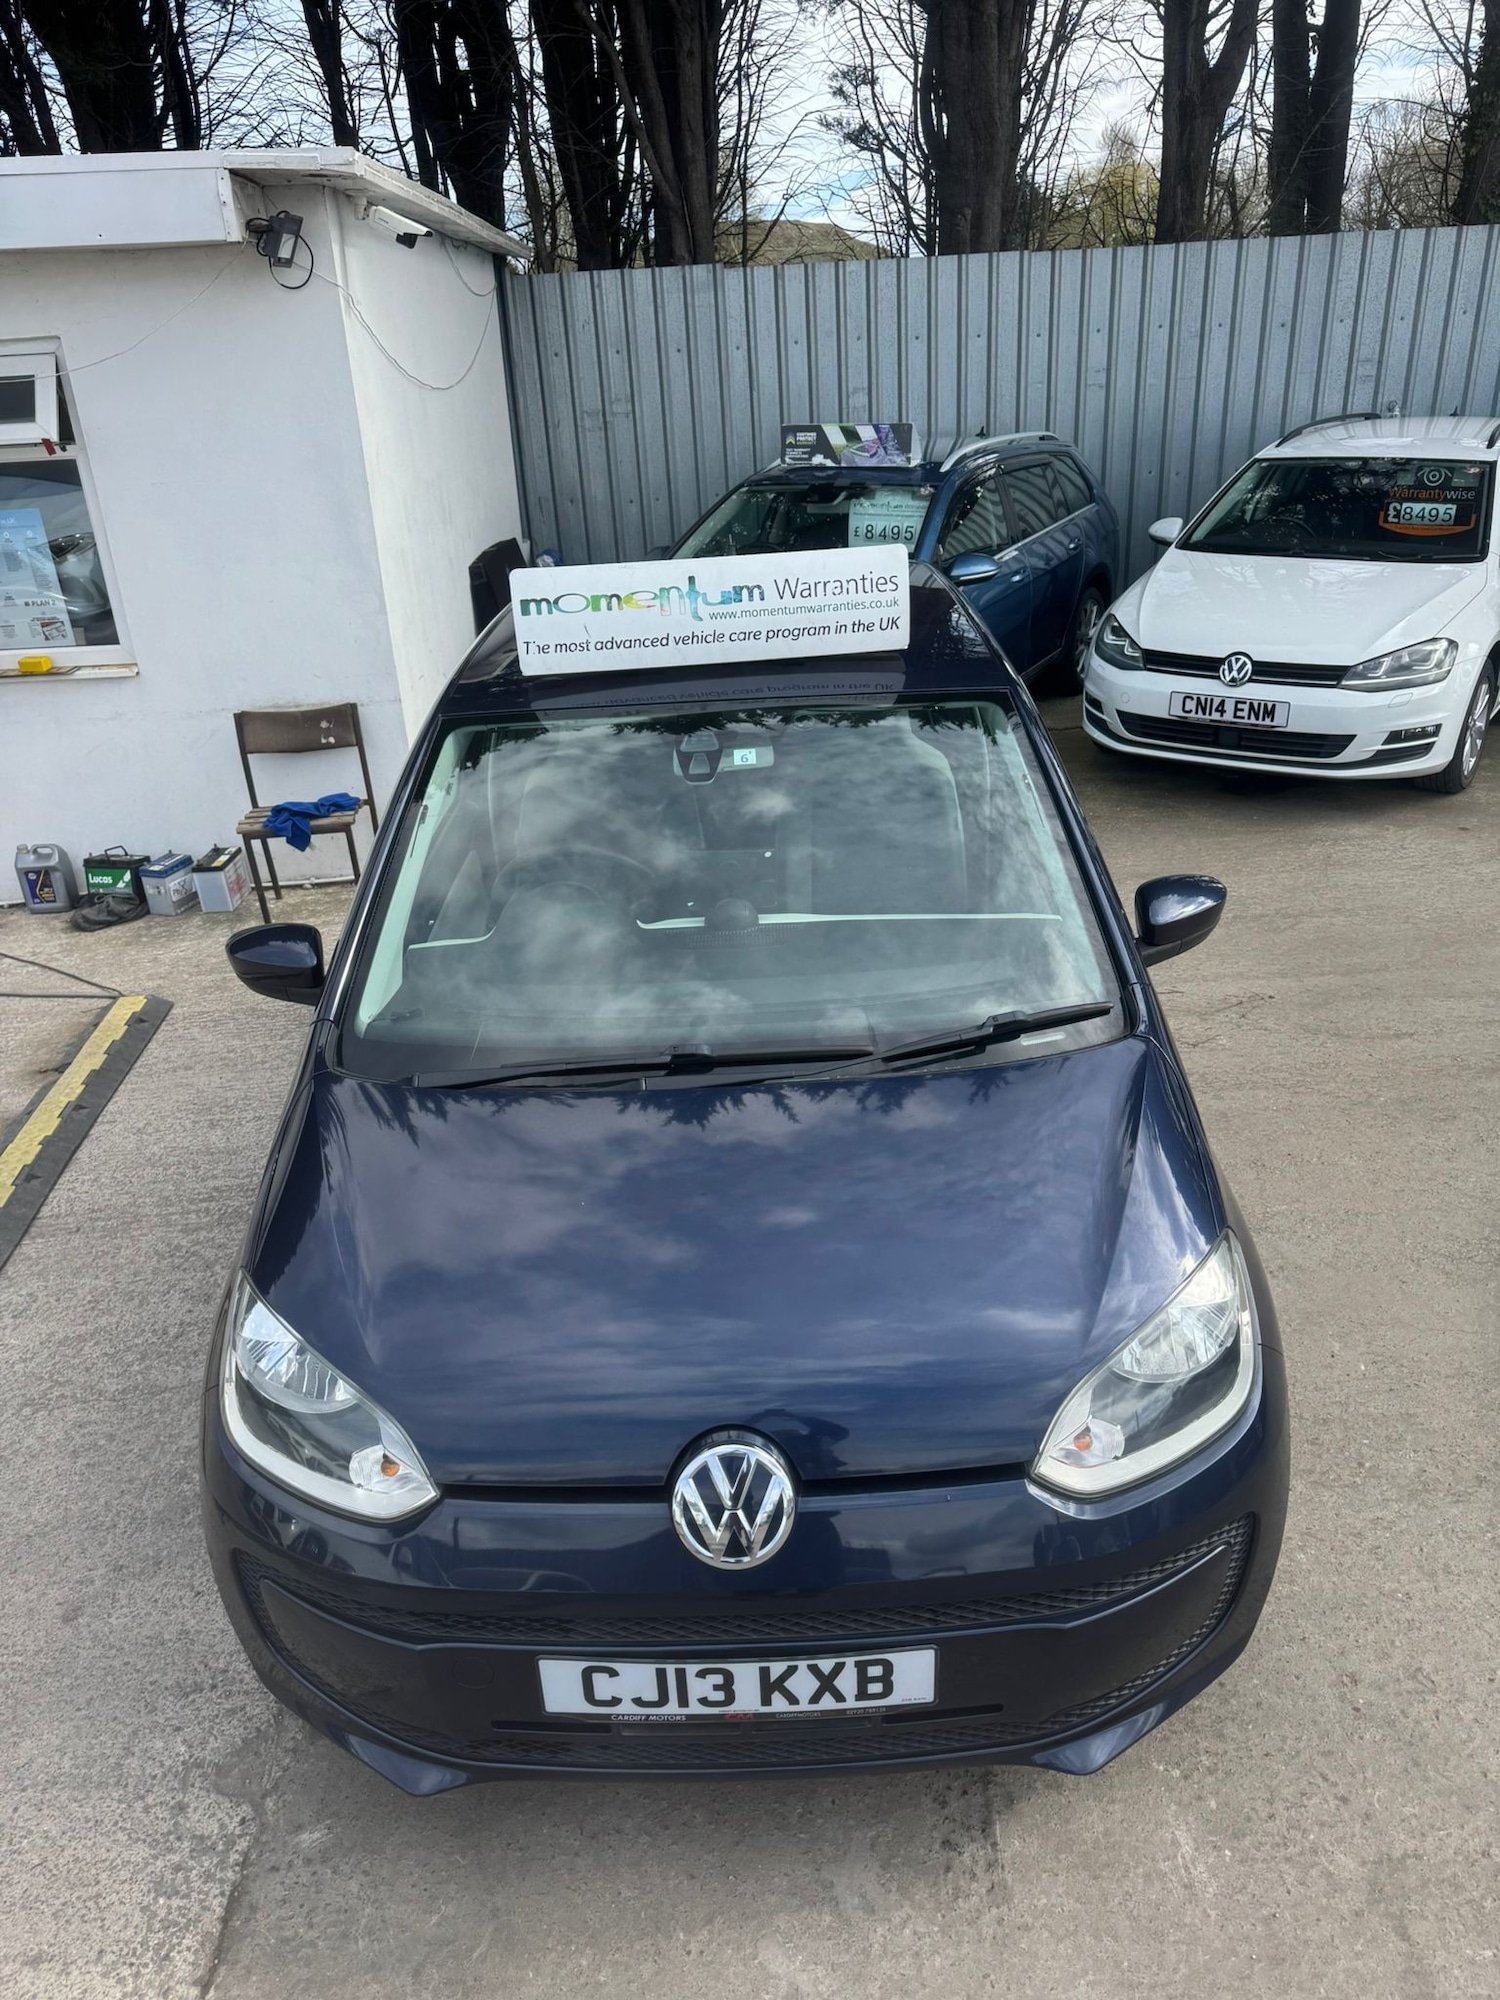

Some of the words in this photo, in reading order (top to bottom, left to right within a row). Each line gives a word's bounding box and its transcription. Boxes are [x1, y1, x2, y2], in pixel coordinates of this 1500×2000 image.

[519, 575, 765, 622] momentum
[773, 571, 899, 600] Warranties
[708, 596, 900, 621] www.momentumwarranties.co.uk
[555, 639, 591, 653] most
[594, 633, 670, 650] advanced
[673, 629, 725, 646] vehicle
[729, 630, 762, 642] care
[765, 623, 831, 643] program
[834, 621, 848, 634] in
[851, 619, 875, 633] the
[879, 616, 901, 630] UK
[1181, 695, 1227, 718] CN14
[1233, 700, 1277, 723] ENM
[88, 872, 113, 884] Lucas
[581, 1665, 736, 1708] CJ13
[758, 1658, 895, 1707] KXB
